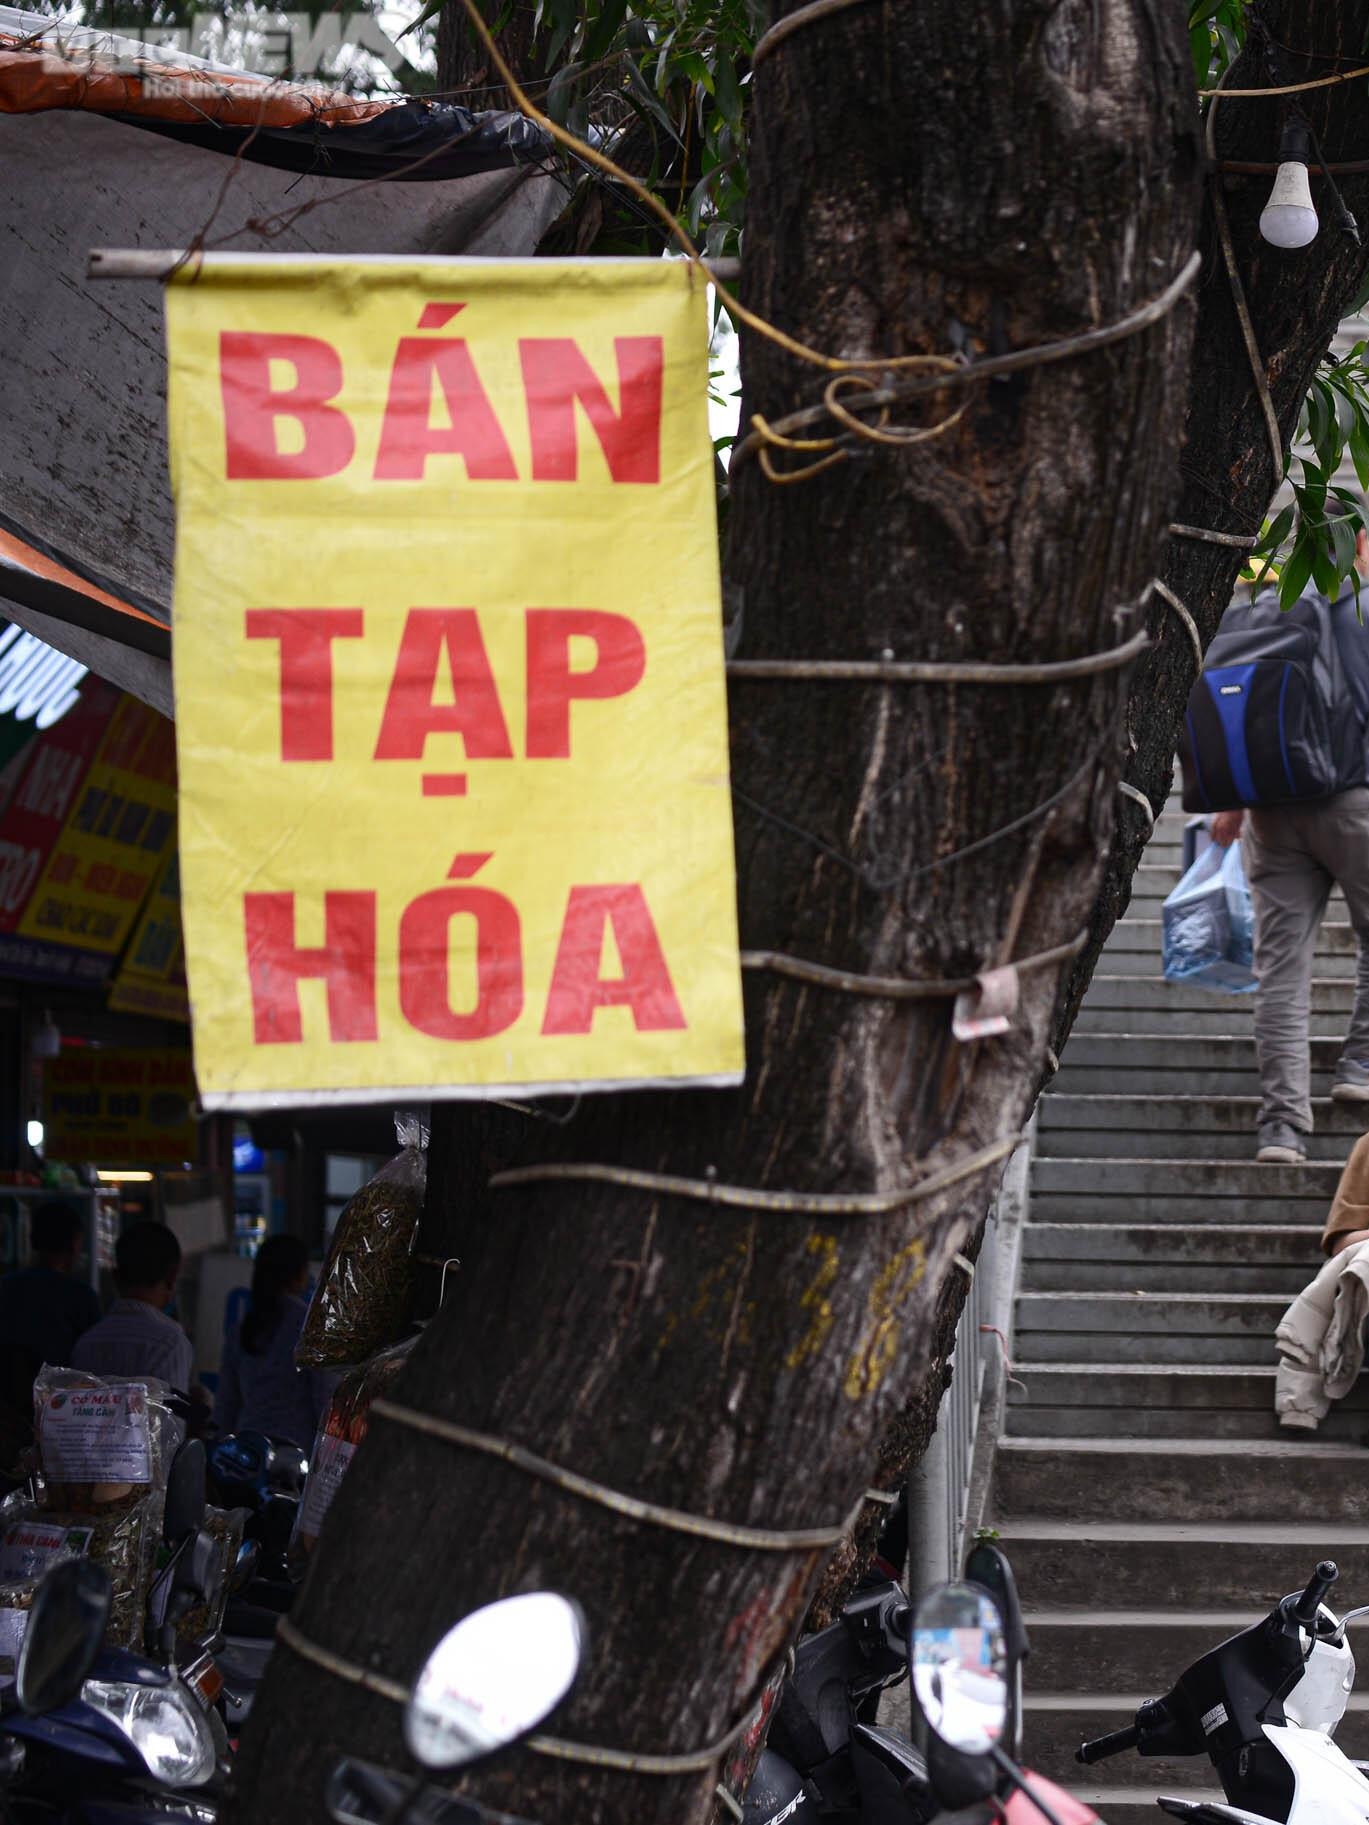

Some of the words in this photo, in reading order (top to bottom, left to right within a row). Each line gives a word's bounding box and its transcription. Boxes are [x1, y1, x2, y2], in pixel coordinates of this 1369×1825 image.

[218, 302, 664, 483] BÁN
[245, 608, 646, 797] TẠP
[243, 851, 687, 1045] HÓA
